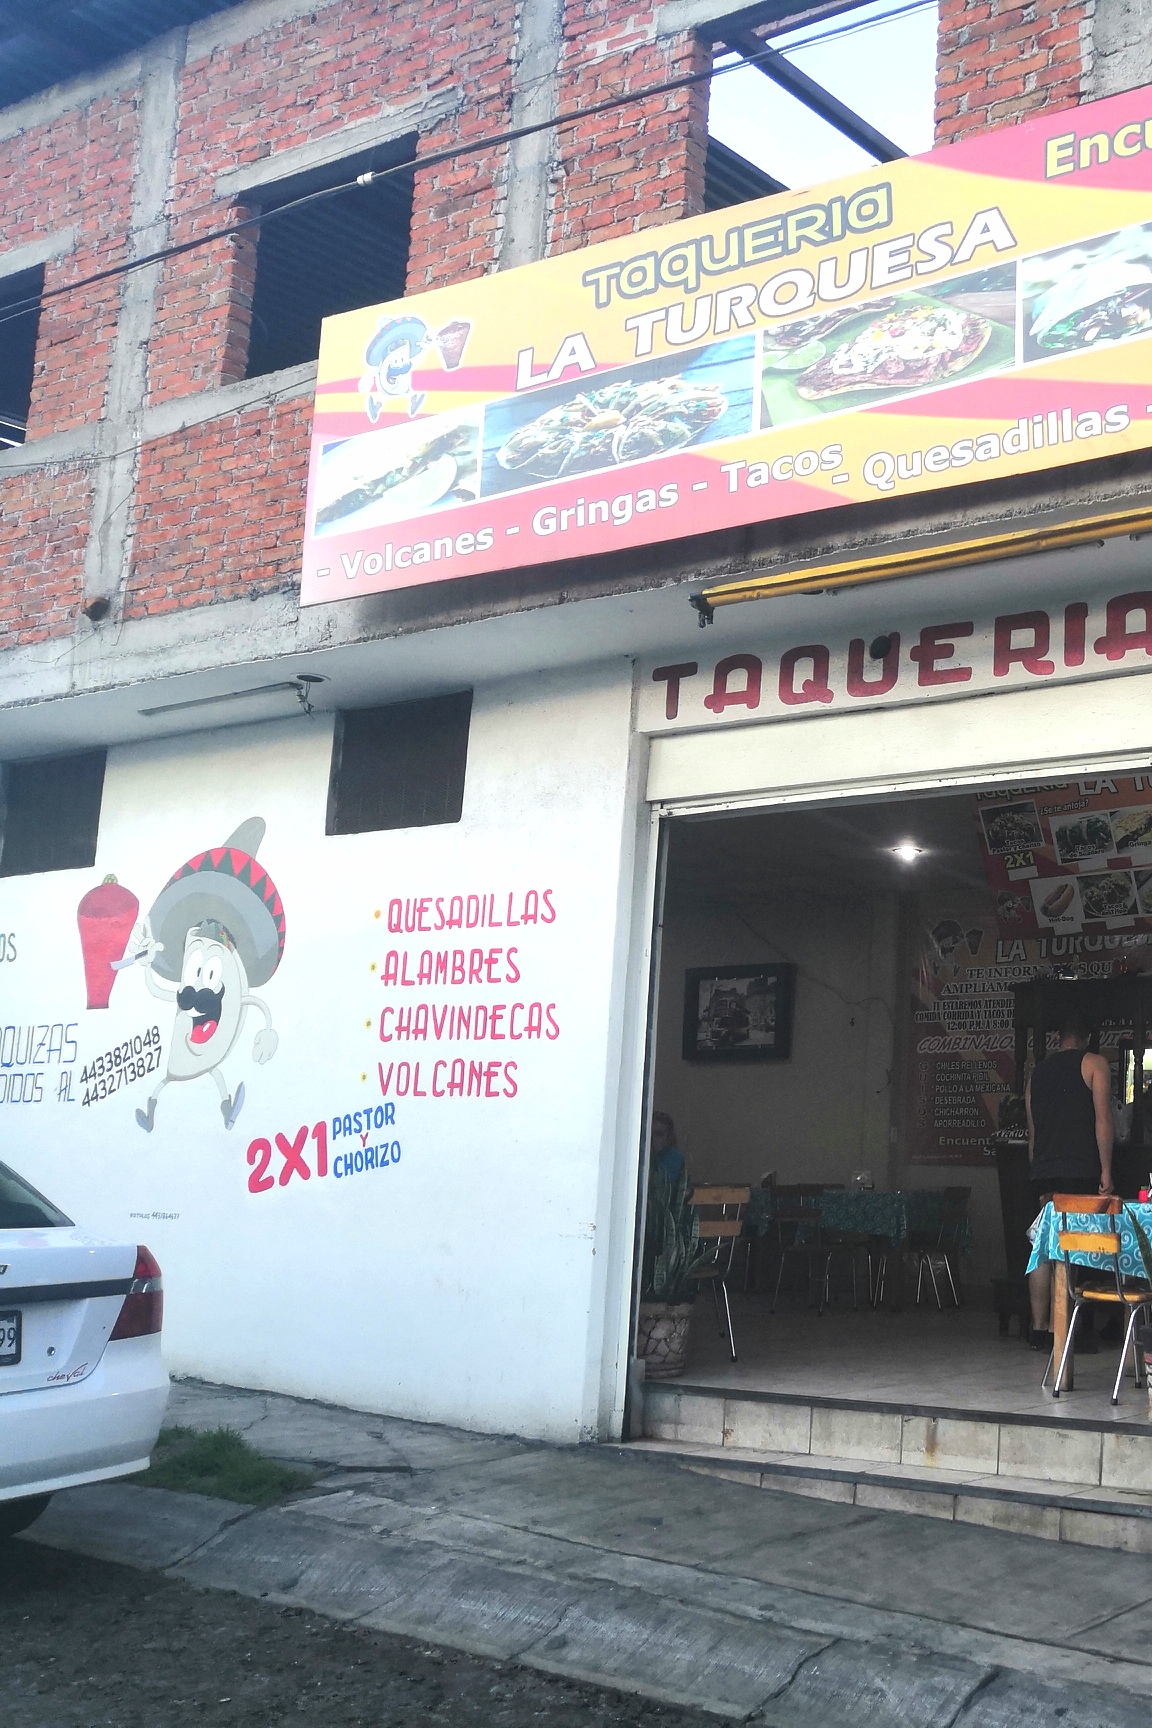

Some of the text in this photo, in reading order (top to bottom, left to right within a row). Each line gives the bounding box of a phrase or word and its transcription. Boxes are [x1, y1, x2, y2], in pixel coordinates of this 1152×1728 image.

[513, 205, 1018, 392] LA TURQUESA
[340, 522, 496, 582] Volcanes
[531, 477, 681, 538] Gringas
[720, 442, 844, 495] Tacos
[861, 400, 1132, 493] Quesadillas
[387, 888, 557, 934] QUESADILLAS
[380, 947, 522, 988] ALAMBRES
[995, 938, 1028, 964] LA
[967, 967, 985, 980] TE
[378, 1001, 561, 1043] CHAVINDECAS
[0, 1022, 79, 1068] QUIZAS
[79, 1025, 161, 1085] 4433821048
[56, 1069, 76, 1102] AL
[81, 1045, 163, 1107] 4432713827
[376, 1058, 520, 1099] VOLCANES
[331, 1101, 397, 1141] PASTOR
[359, 1132, 370, 1148] Y
[938, 1136, 992, 1147] Encuent
[246, 1120, 329, 1195] 2X1
[332, 1140, 402, 1179] CHORIZO
